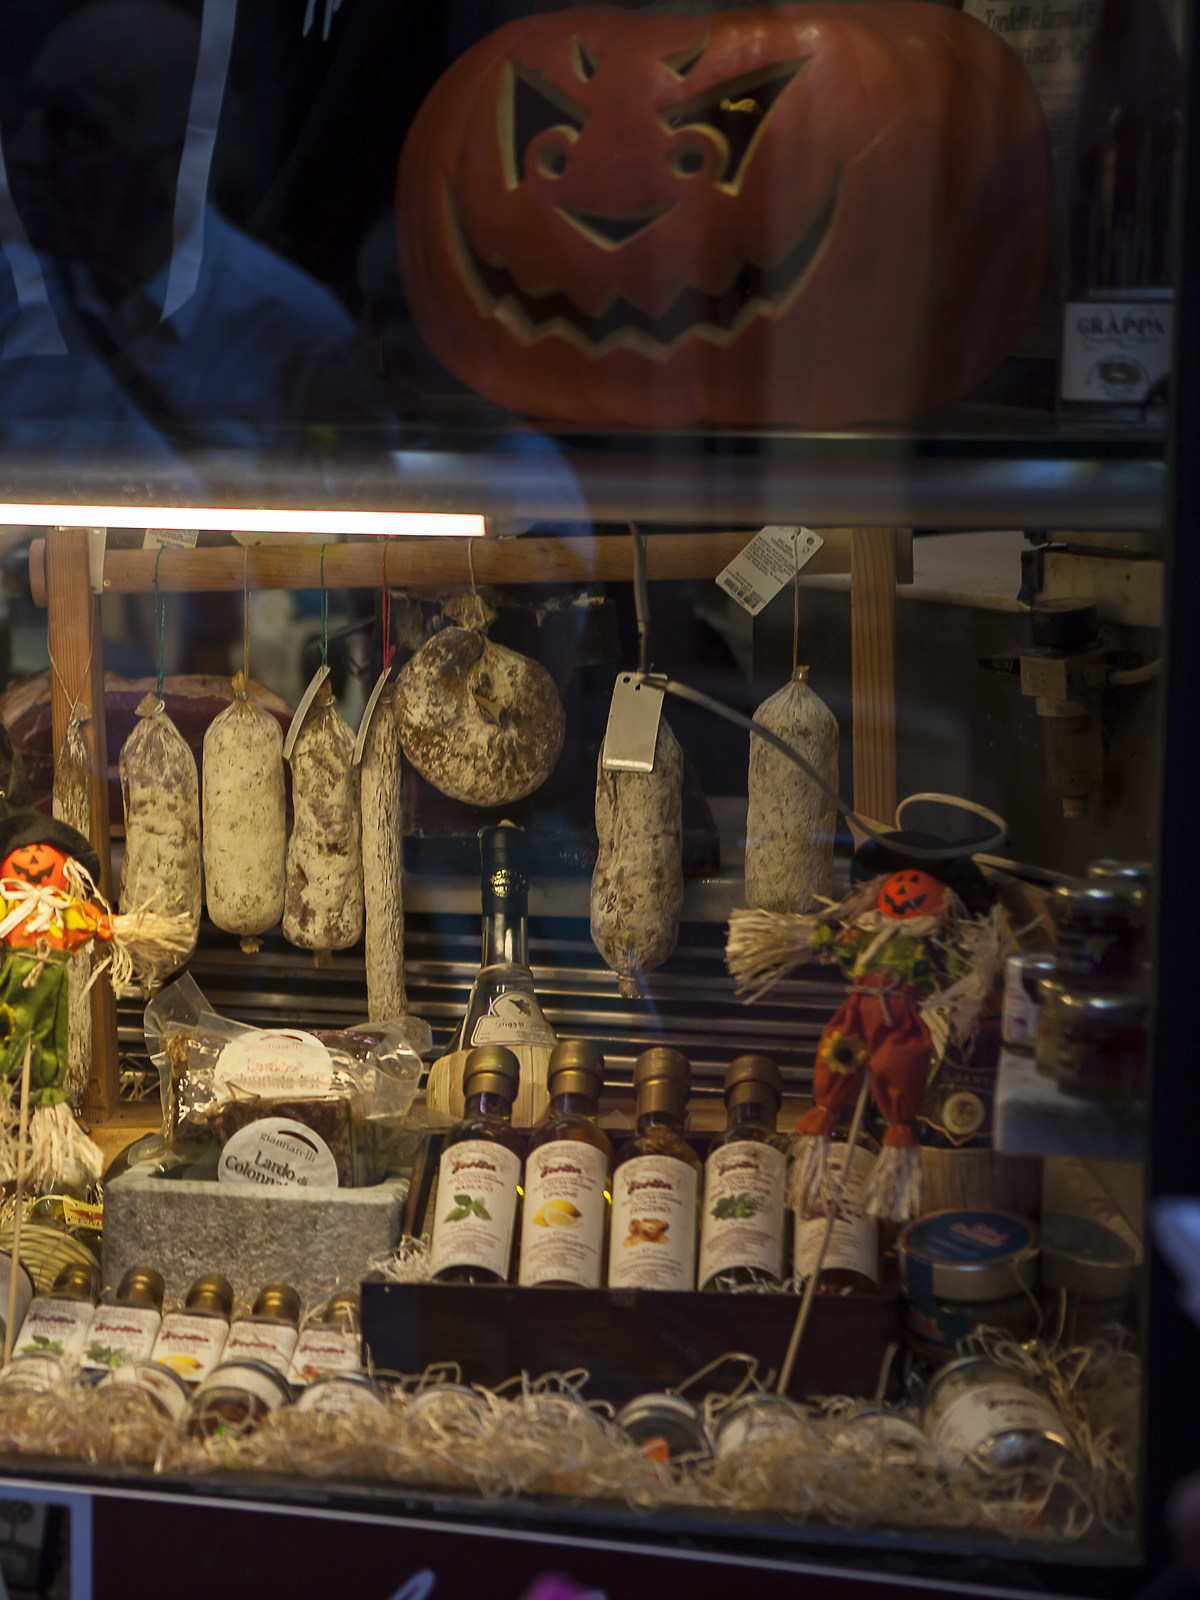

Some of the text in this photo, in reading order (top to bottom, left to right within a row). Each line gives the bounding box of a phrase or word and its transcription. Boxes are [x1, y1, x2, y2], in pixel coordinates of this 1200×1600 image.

[1077, 317, 1165, 335] GRAPPA
[259, 1131, 317, 1163] giannarelli
[254, 1150, 309, 1187] Lardo di
